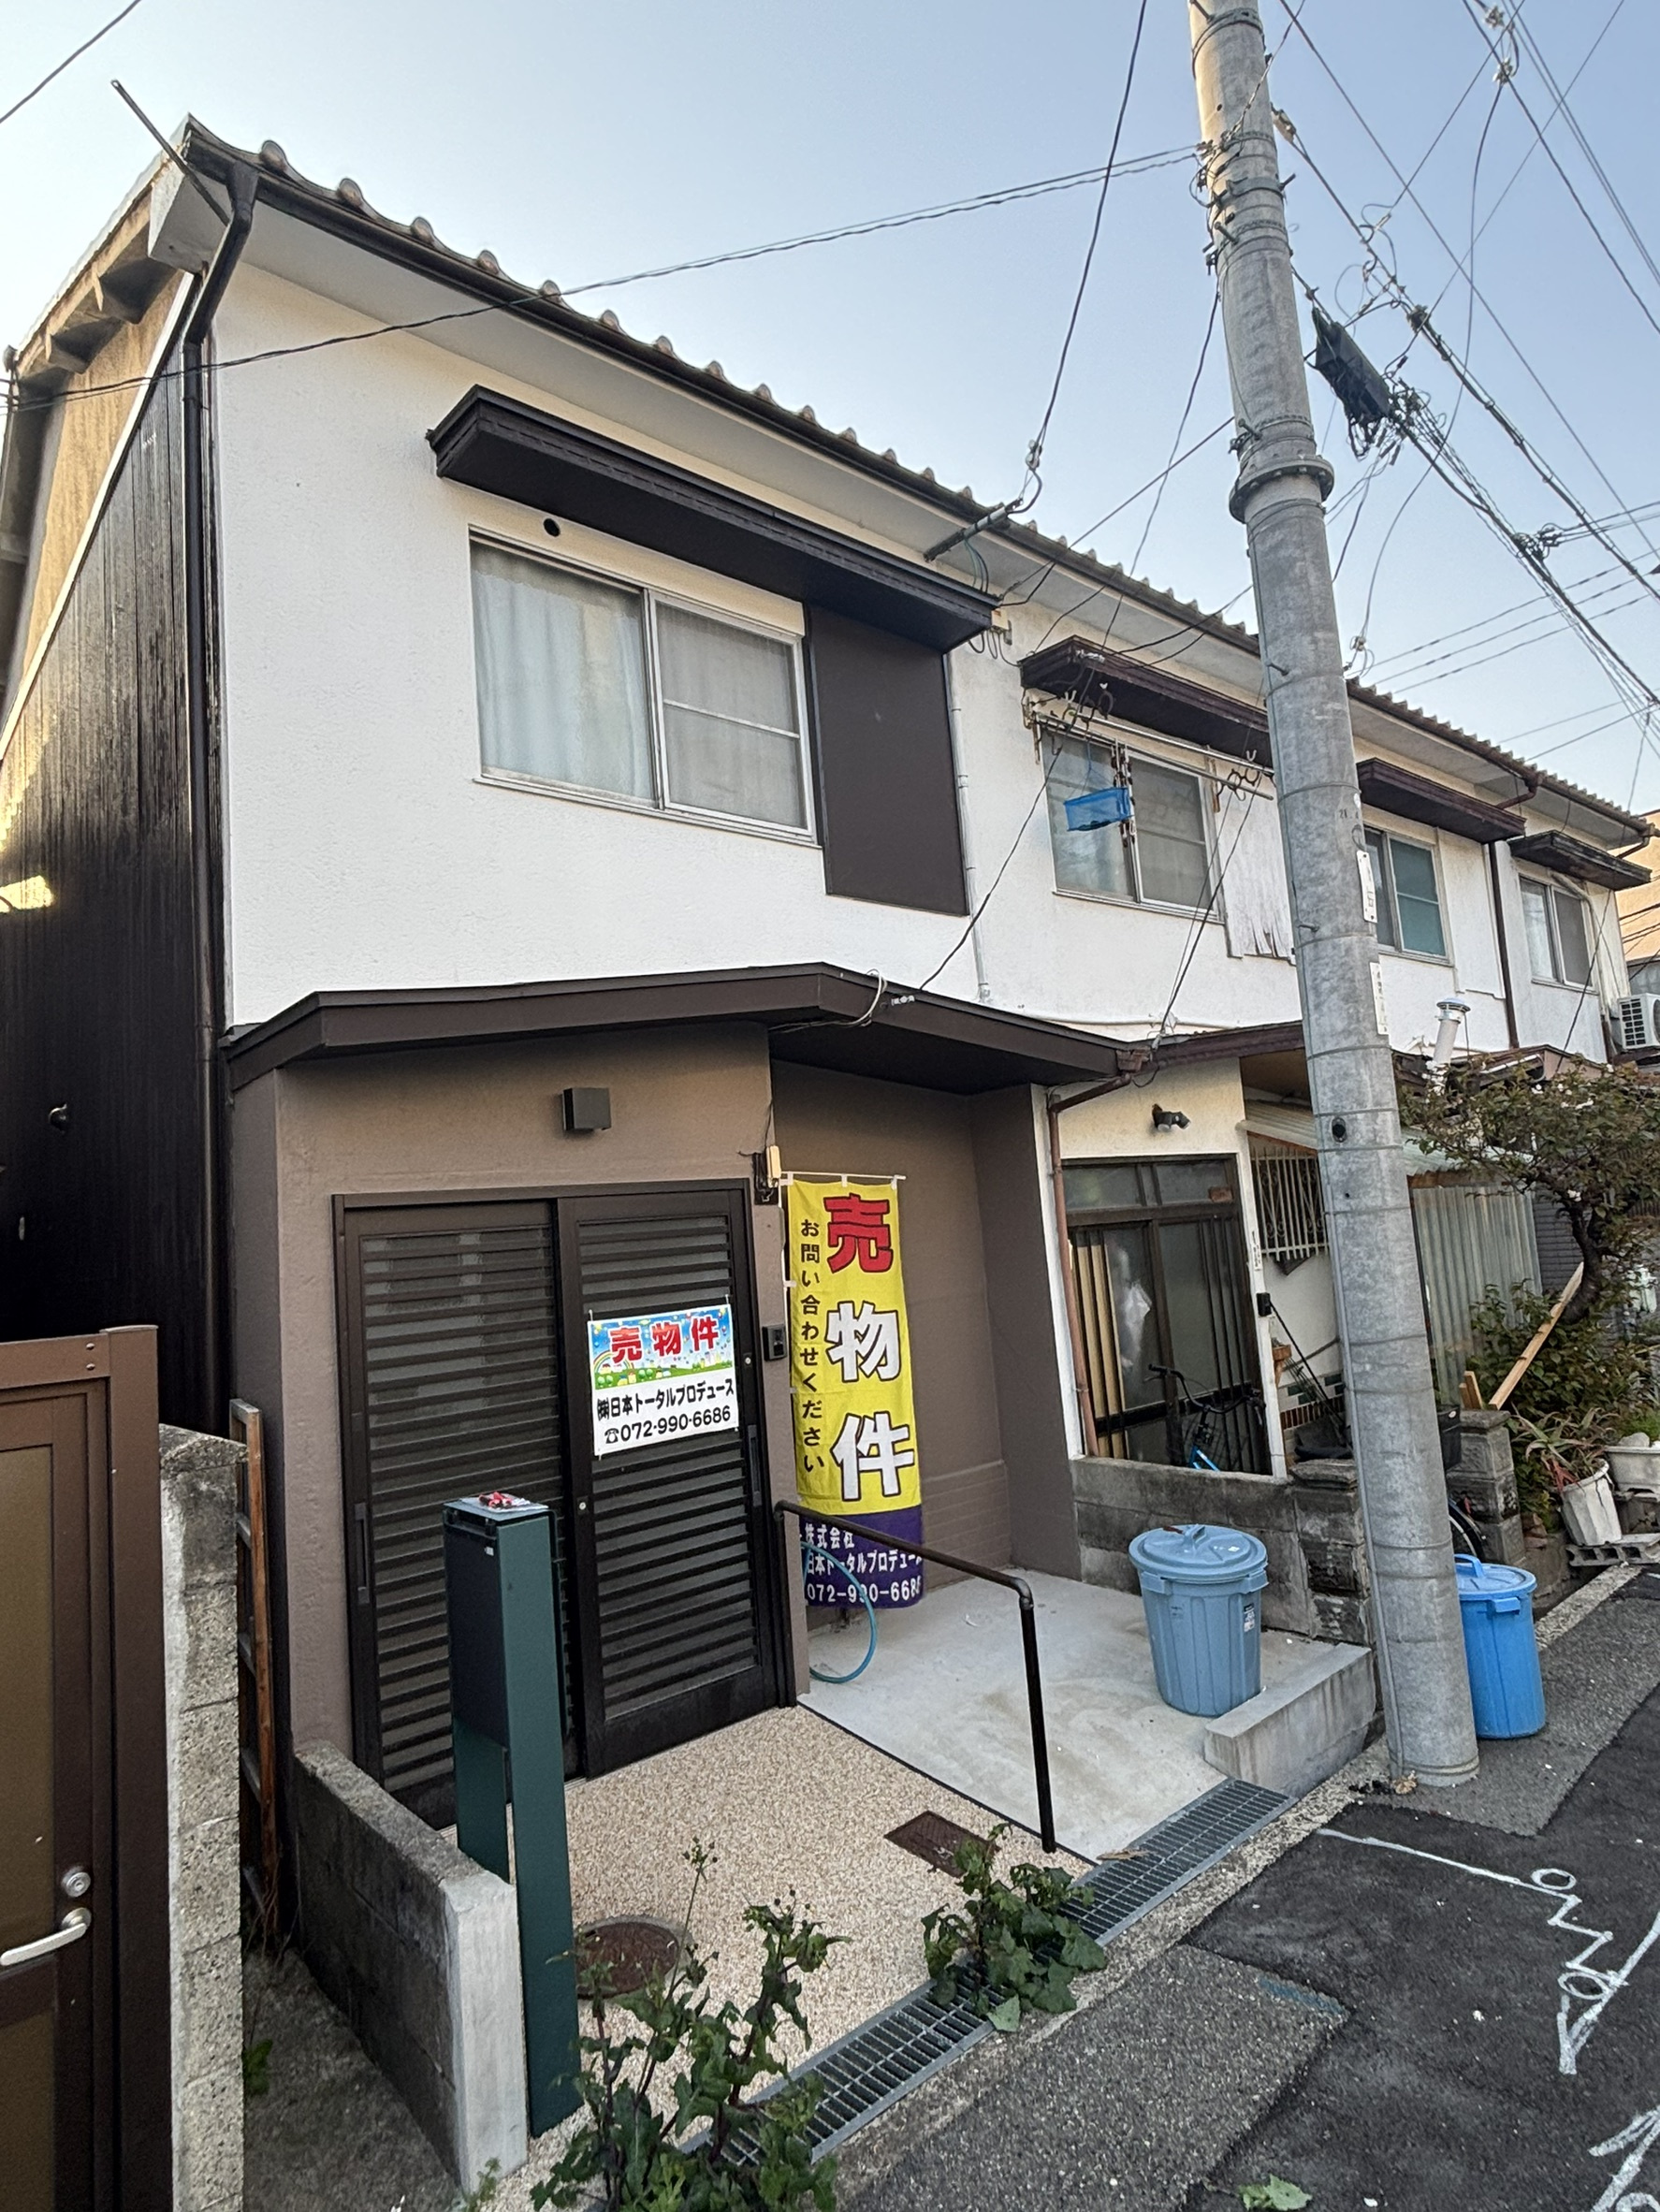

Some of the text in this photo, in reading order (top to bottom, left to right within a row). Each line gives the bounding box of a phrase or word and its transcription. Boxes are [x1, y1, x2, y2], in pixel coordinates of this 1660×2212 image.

[610, 1316, 720, 1364] 売物件
[800, 1219, 824, 1472] お問い合わせください
[823, 1192, 914, 1502] 売物件
